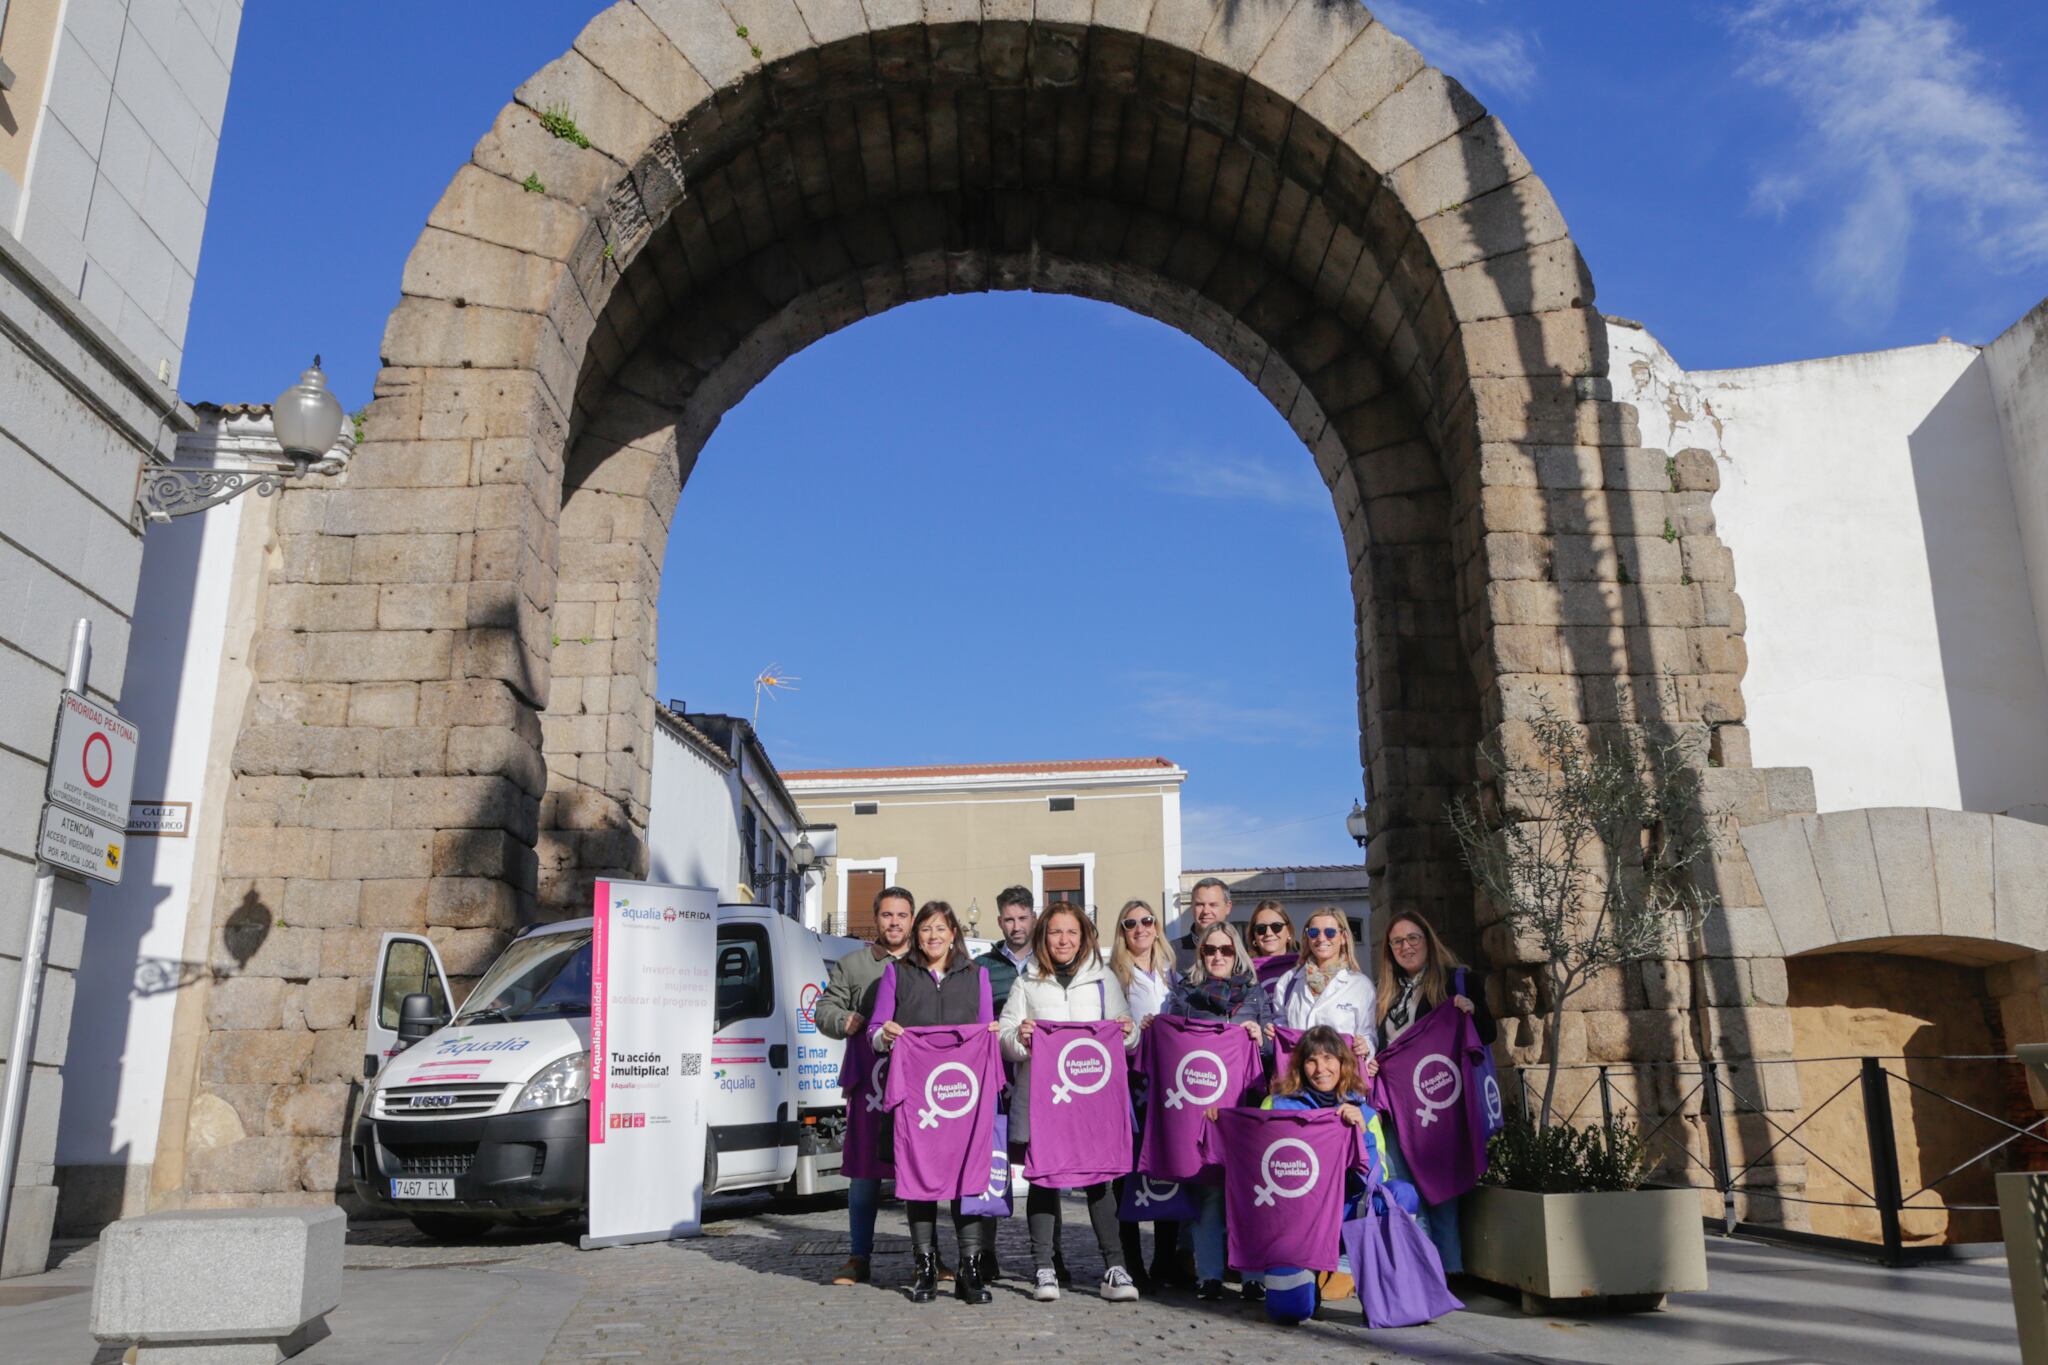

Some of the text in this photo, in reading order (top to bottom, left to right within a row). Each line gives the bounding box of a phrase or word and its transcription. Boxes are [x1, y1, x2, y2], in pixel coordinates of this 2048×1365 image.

[67, 696, 136, 745] PRIORIDAD PEATONAL
[142, 807, 176, 817] CALLE
[61, 817, 95, 839] ATENCIÓN
[160, 821, 183, 830] ARCO
[46, 830, 104, 858] ACCESO VIDEOVIGILADO
[47, 846, 60, 857] POR
[81, 858, 98, 871] LOCAL
[622, 907, 661, 921] aqualia
[693, 967, 709, 977] las
[611, 994, 708, 1008] acelerar el progreso
[592, 981, 603, 1080] #AqualiaIgualdad
[437, 1037, 532, 1056] aqualia
[797, 1046, 828, 1059] El mar
[611, 1052, 661, 1063] Tu acción
[1066, 1058, 1100, 1068] #Aqualia
[611, 1065, 670, 1078] ¡multiplica!
[798, 1061, 838, 1076] empieza
[1070, 1065, 1104, 1076] Igualdad
[1184, 1068, 1217, 1080] #Aqualia
[720, 1075, 756, 1093] aqualia
[799, 1080, 810, 1090] en
[812, 1078, 823, 1089] tu
[1186, 1076, 1218, 1088] Igualdad
[1421, 1071, 1449, 1089] #Aqualia
[1426, 1074, 1454, 1095] Igualdad
[933, 1082, 968, 1092] #Aqualia
[937, 1089, 970, 1101] Igualdad
[1270, 1160, 1307, 1170] #Aqualia
[1274, 1168, 1310, 1178] Igualdad
[397, 1181, 449, 1196] 7467 FLK
